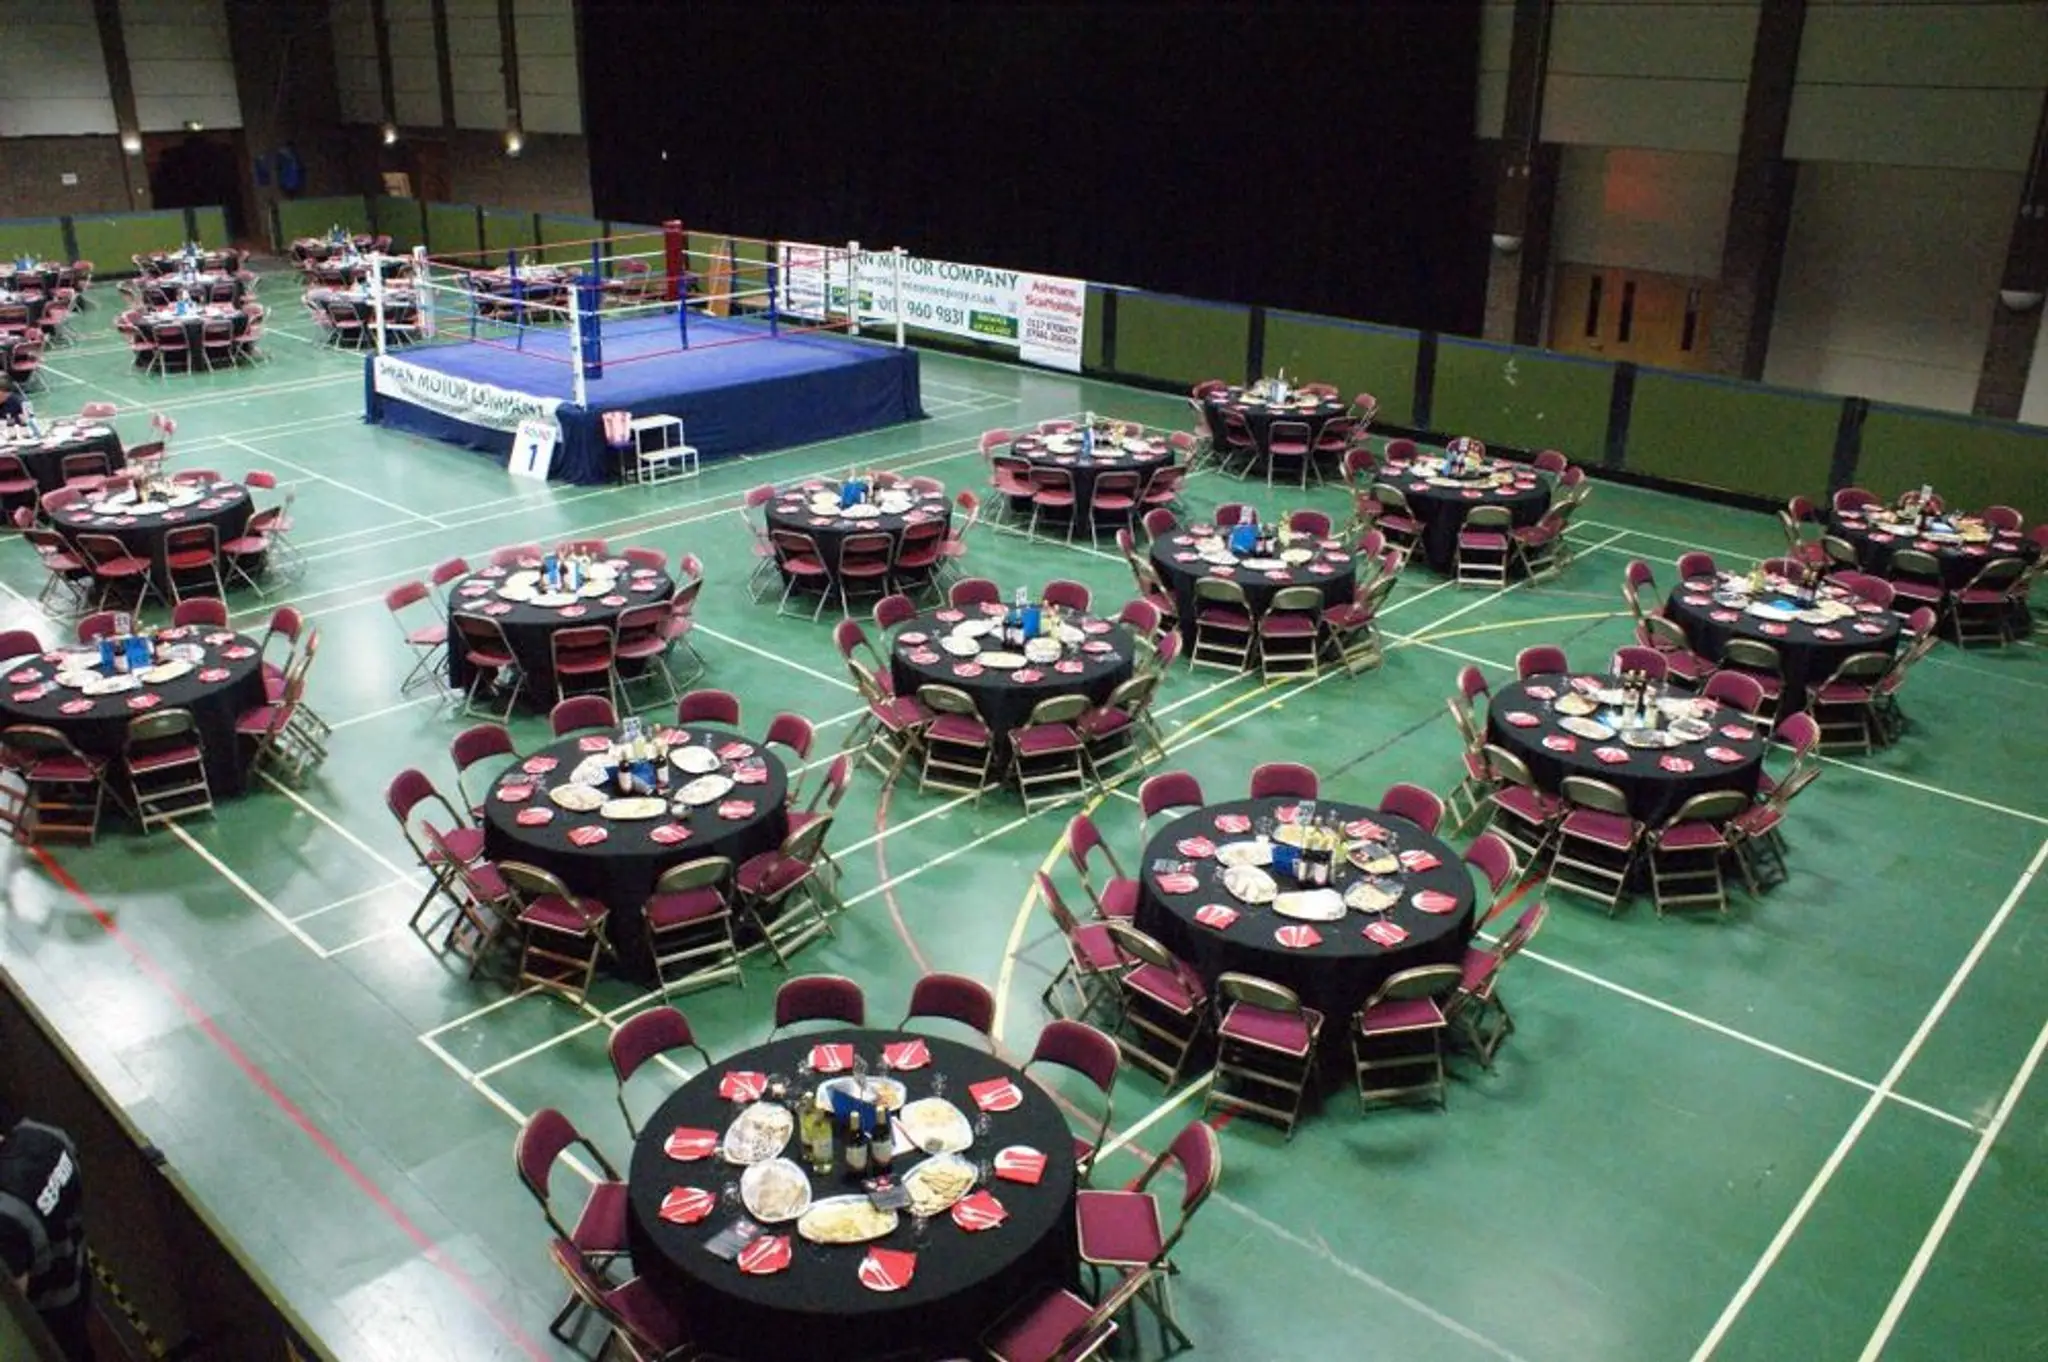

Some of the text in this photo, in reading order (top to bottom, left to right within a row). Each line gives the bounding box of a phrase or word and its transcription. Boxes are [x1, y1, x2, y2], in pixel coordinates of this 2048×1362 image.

[938, 263, 1019, 290] COMPANY
[907, 300, 932, 319] 960
[936, 305, 964, 325] 9831
[528, 443, 539, 472] 1
